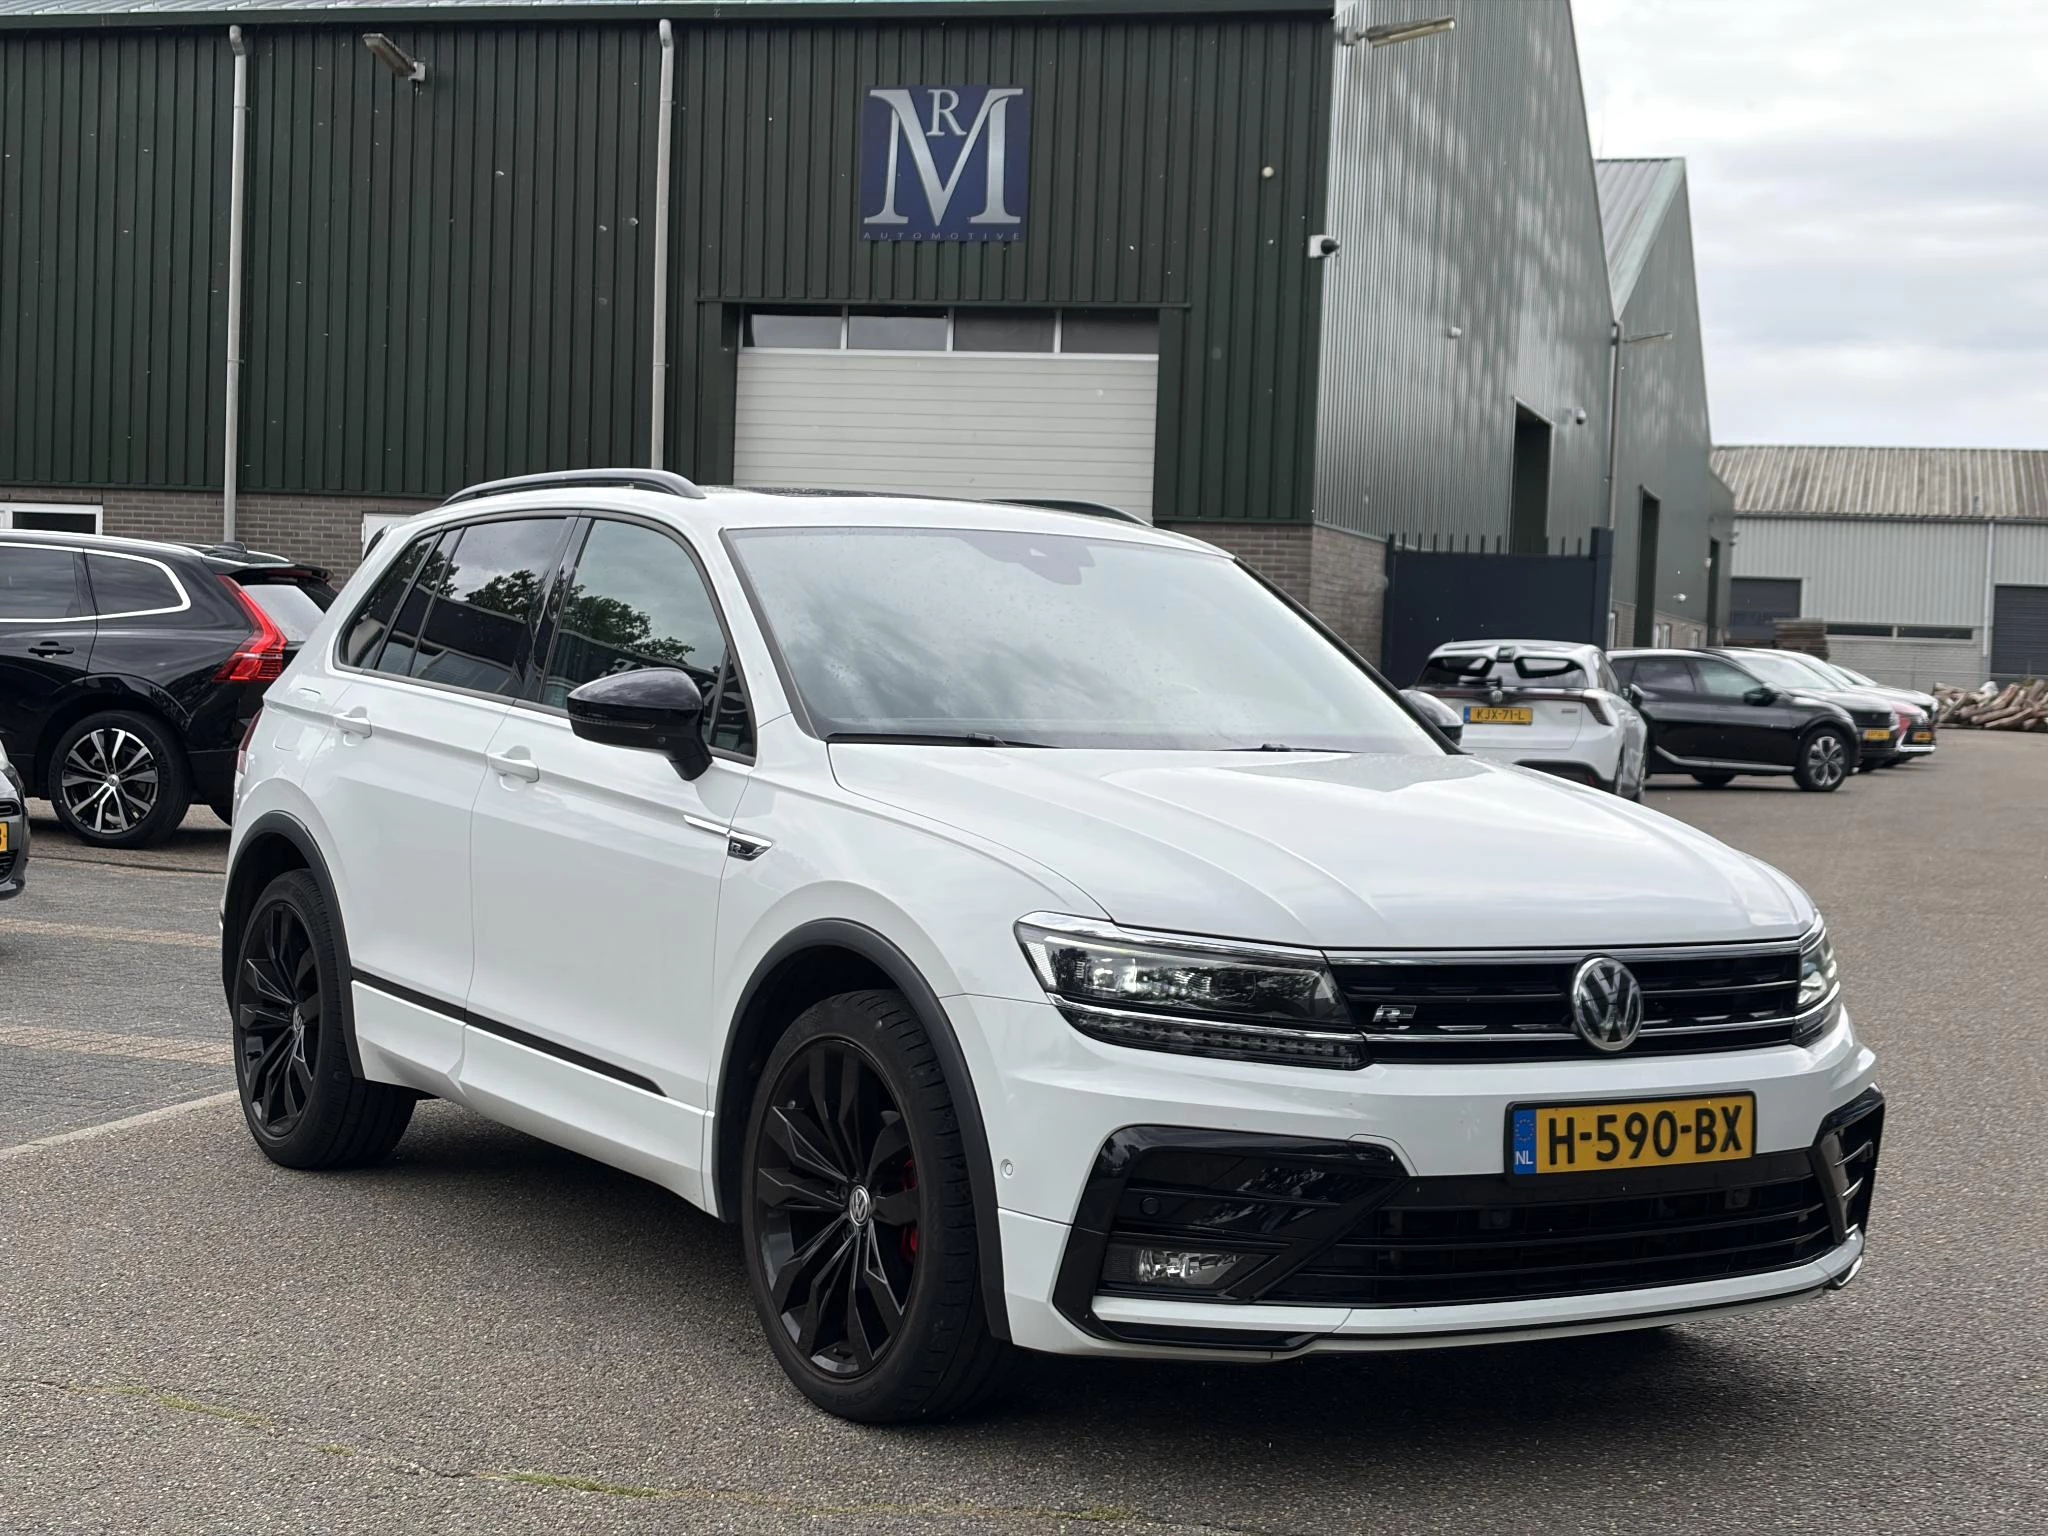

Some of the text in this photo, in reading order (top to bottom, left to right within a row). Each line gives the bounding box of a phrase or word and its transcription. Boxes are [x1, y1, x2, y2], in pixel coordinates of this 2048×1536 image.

[863, 232, 1020, 240] AUTOMOTIVE
[1476, 709, 1525, 720] KJX-71-L
[1549, 1105, 1742, 1165] H-590-BX
[1515, 1150, 1533, 1165] NL
